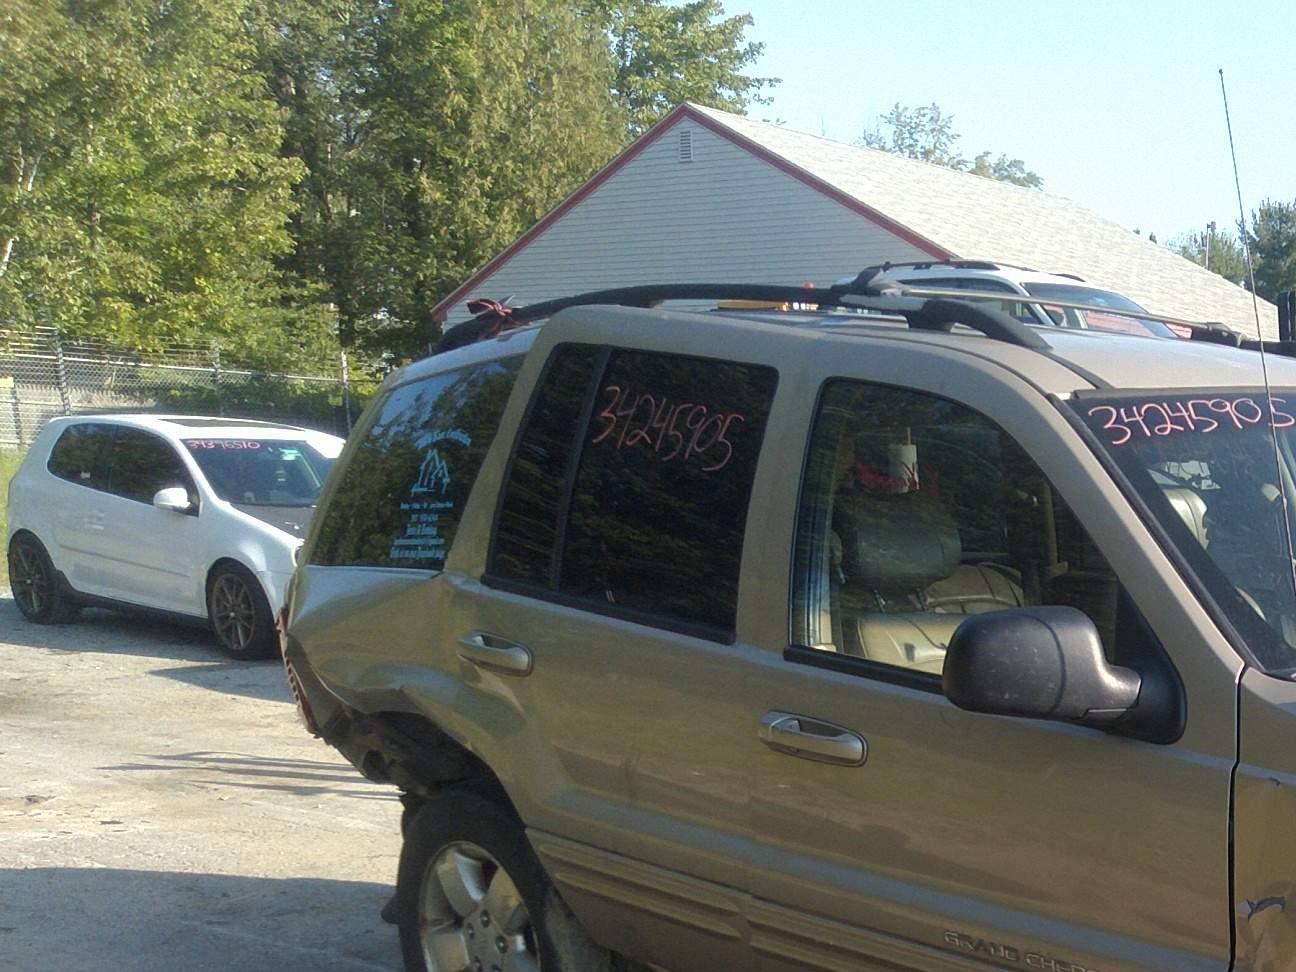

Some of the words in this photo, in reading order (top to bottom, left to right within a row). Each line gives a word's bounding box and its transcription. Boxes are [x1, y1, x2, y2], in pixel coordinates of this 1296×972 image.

[591, 385, 745, 472] 34245905
[1088, 397, 1295, 445] 34245905
[944, 930, 1019, 963] GRAND
